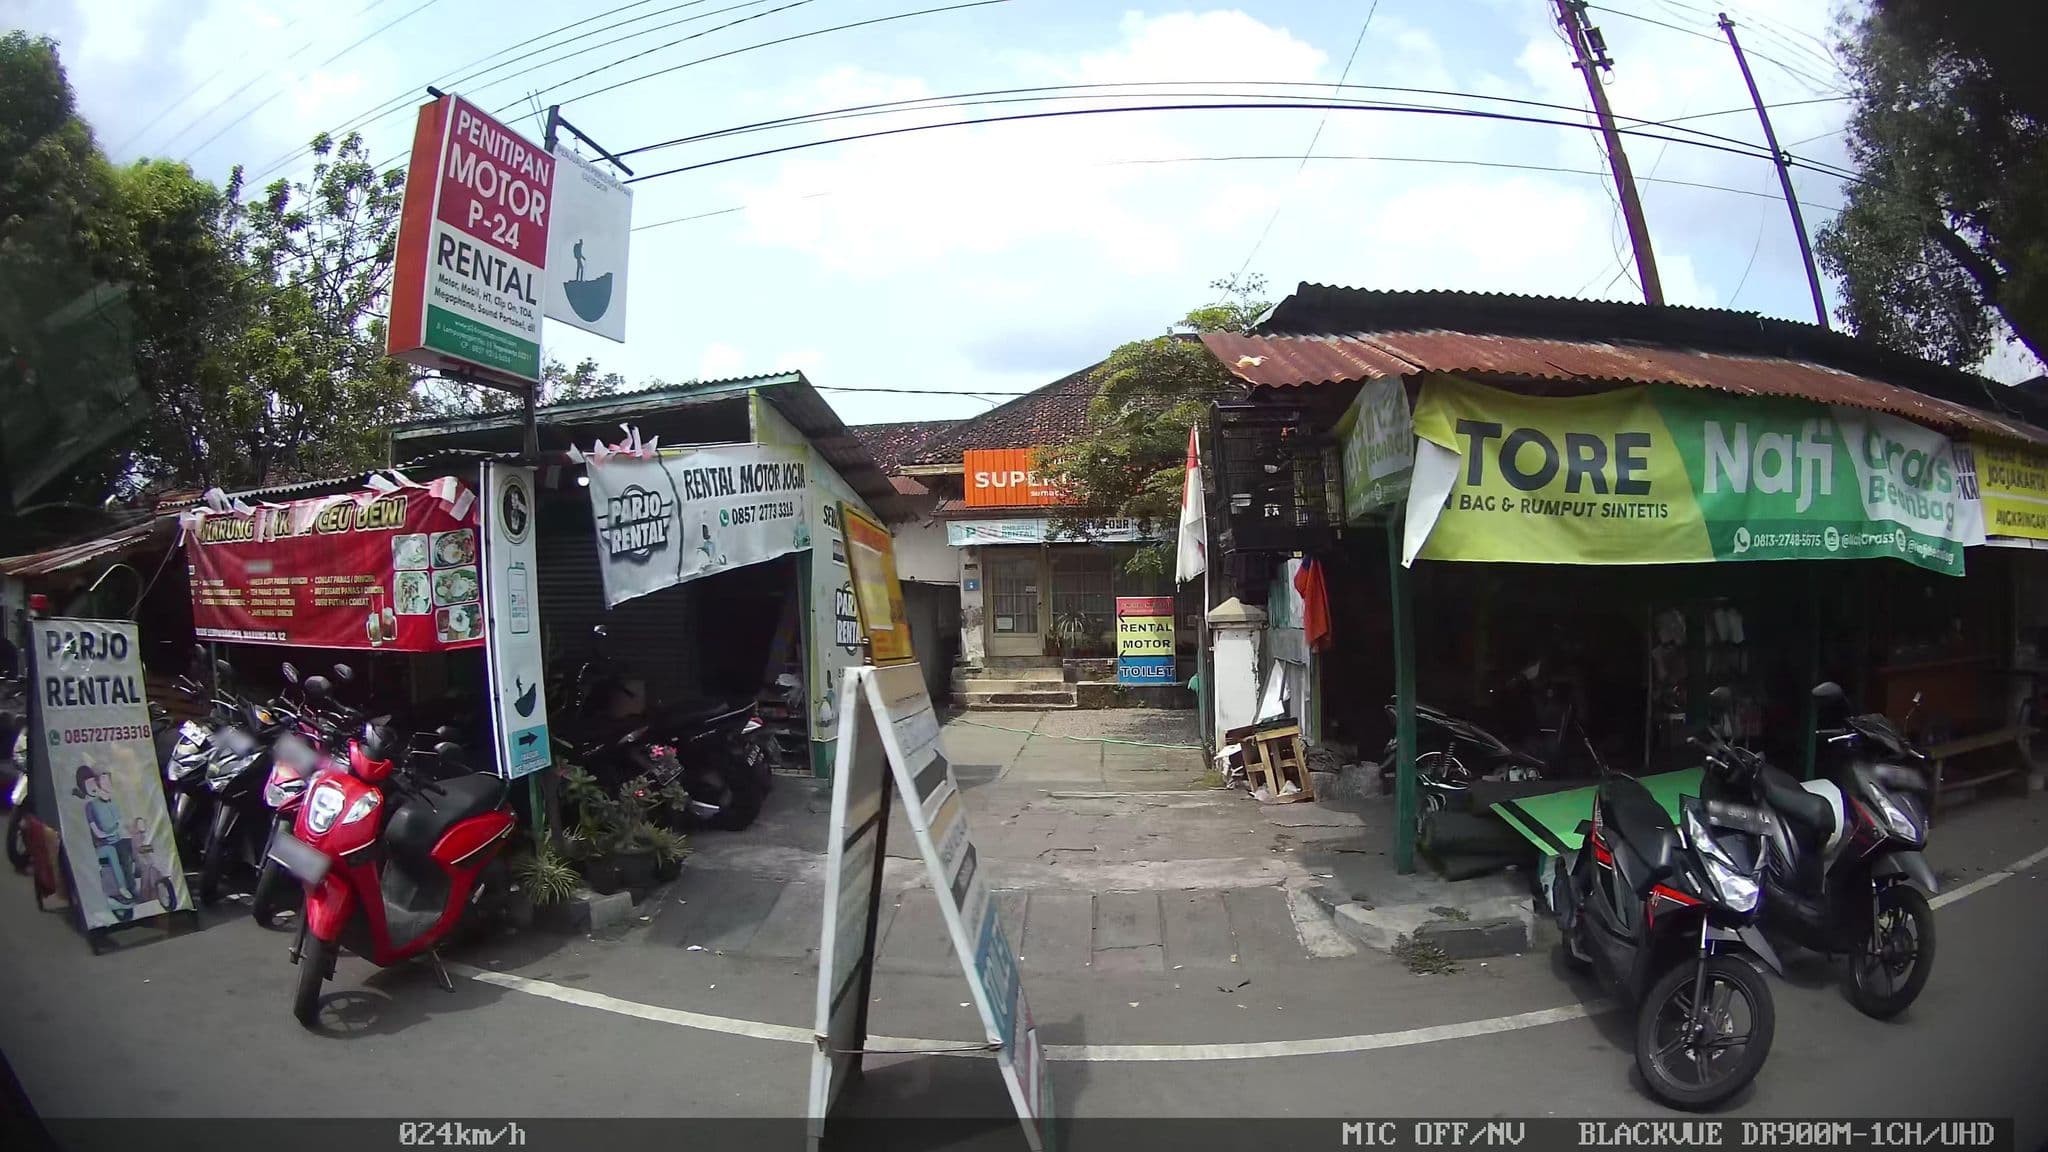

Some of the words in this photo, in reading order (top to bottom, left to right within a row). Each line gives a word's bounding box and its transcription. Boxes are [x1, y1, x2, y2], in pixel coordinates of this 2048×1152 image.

[457, 109, 549, 187] PENITIPAN
[449, 143, 546, 227] MOTOR
[467, 199, 520, 250] P-24
[437, 232, 536, 305] RENTAL
[683, 466, 736, 501] RENTAL
[740, 463, 781, 494] MOTOR
[782, 461, 806, 491] JOGJA
[608, 492, 662, 527] PARJO
[731, 505, 756, 526] 0857
[759, 503, 777, 521] 2773
[1459, 494, 1495, 512] BAG
[1502, 496, 1514, 512] &
[1521, 496, 1596, 518] RUMPUT
[1601, 502, 1668, 518] SINTETIS
[610, 520, 666, 555] RENTAL
[1121, 624, 1172, 632] RENTAL
[46, 630, 128, 662] PARJO
[1123, 640, 1171, 649] MOTOR
[1120, 665, 1174, 677] TOILET
[46, 675, 141, 707] RENTAL
[64, 724, 151, 745] 085727733318
